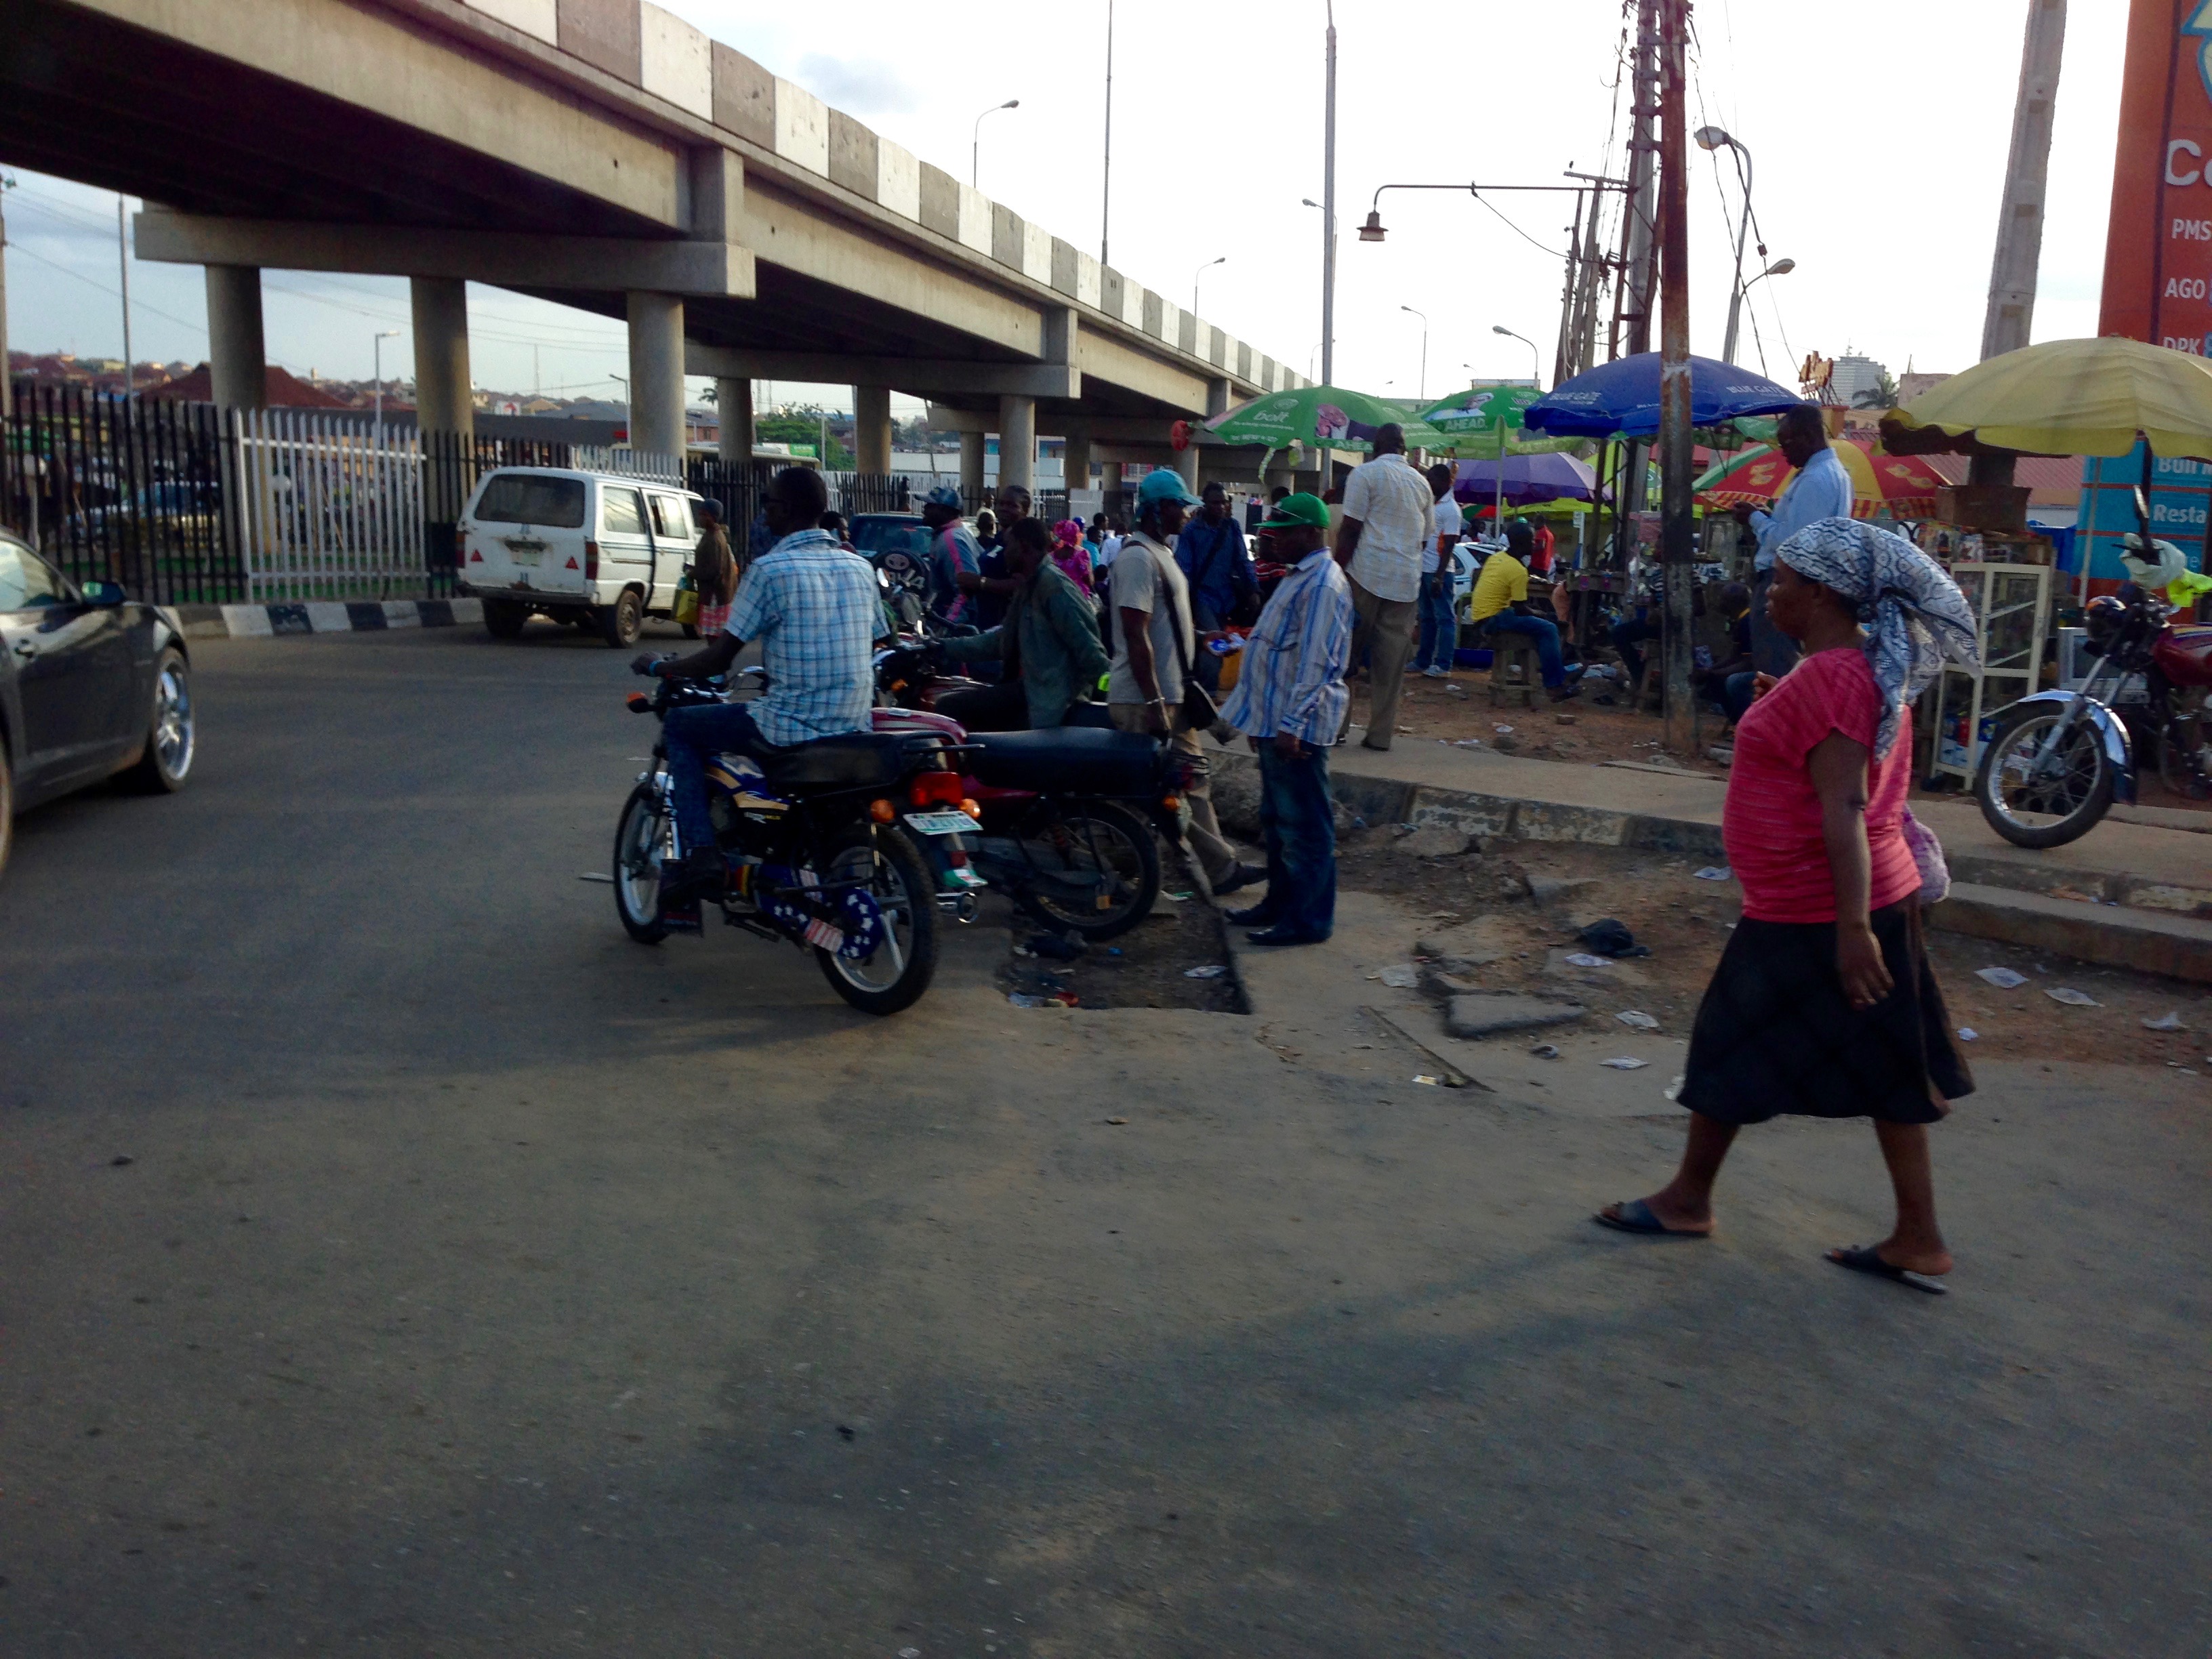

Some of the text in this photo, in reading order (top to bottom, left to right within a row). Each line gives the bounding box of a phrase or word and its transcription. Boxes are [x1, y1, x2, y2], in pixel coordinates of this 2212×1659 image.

[2171, 218, 2212, 241] PMS
[2164, 277, 2206, 300] AGO
[2162, 336, 2201, 354] DPK
[2152, 503, 2207, 524] Resta
